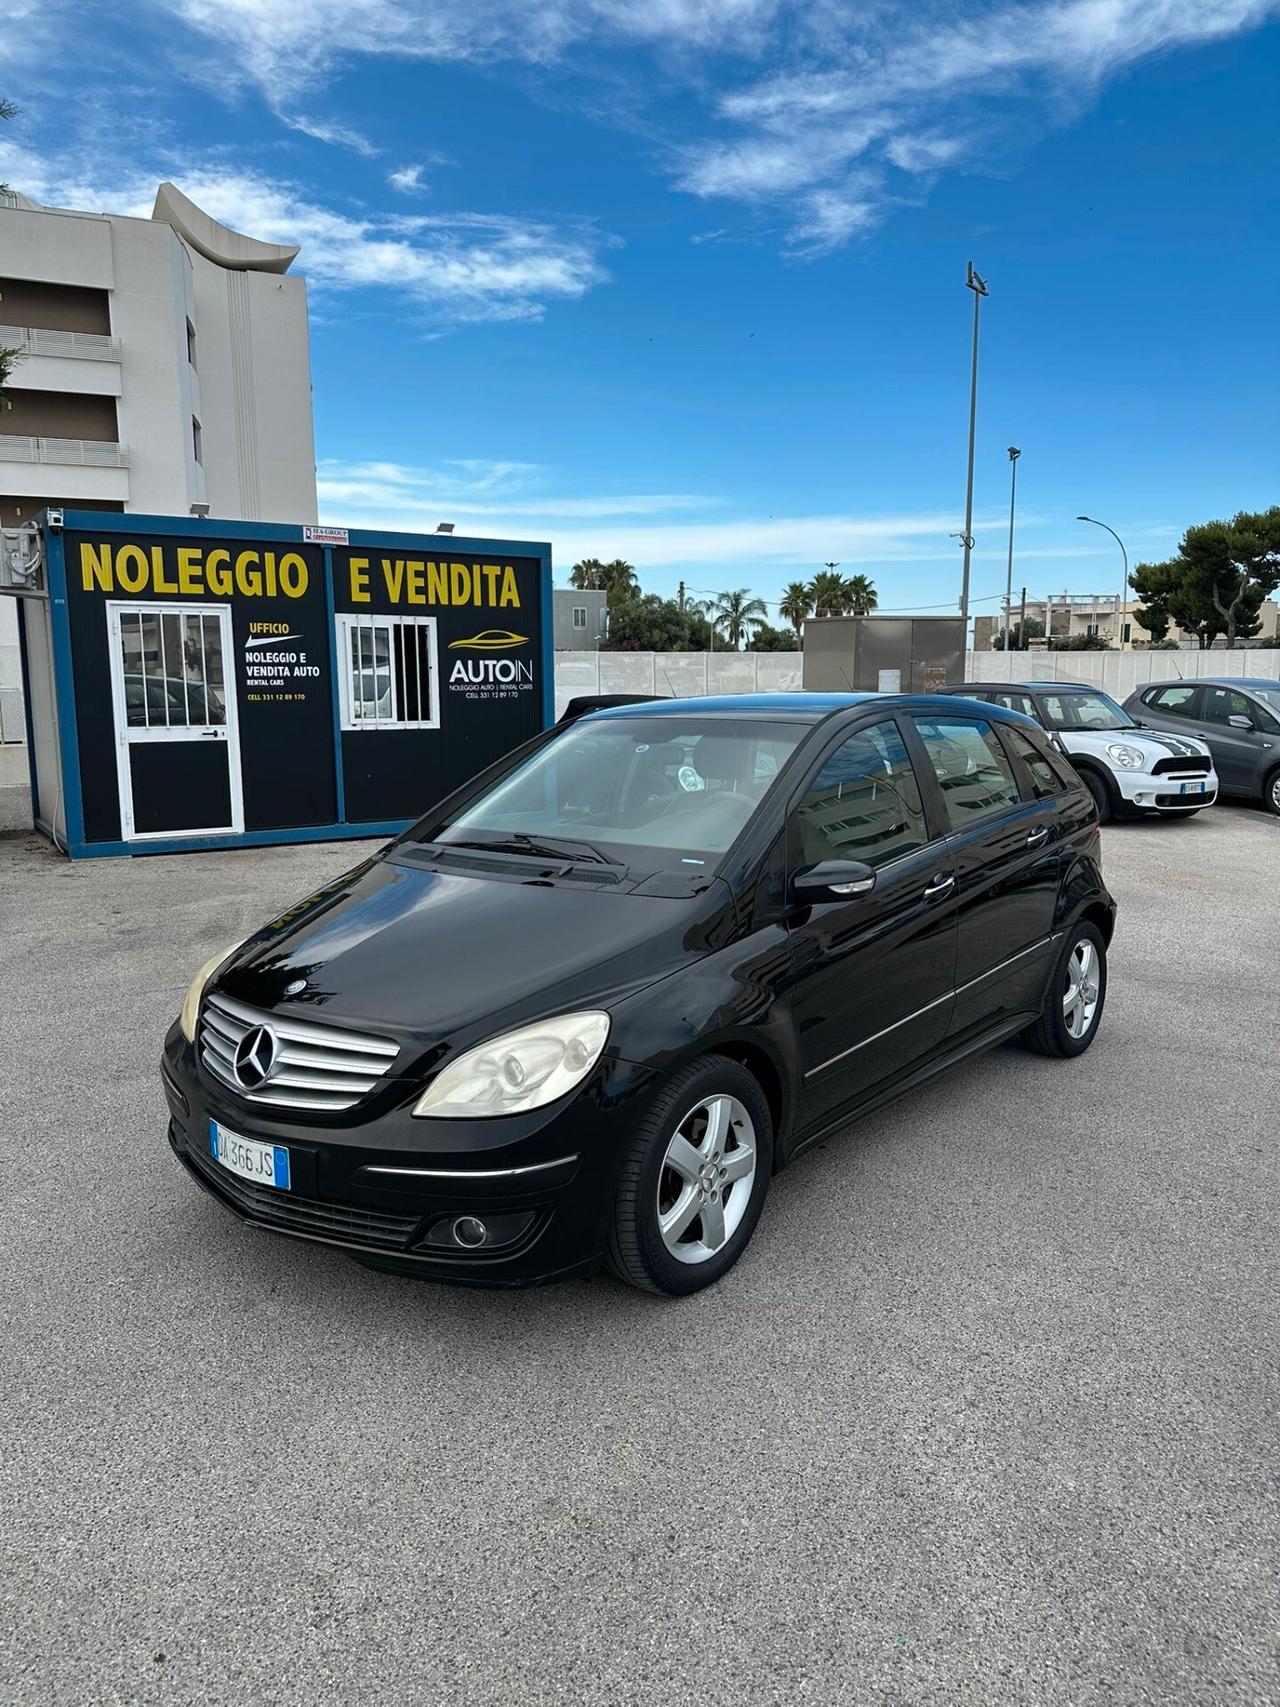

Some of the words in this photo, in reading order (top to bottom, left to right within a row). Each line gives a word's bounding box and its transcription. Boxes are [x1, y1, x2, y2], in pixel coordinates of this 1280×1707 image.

[80, 543, 308, 598] NOLEGGIO
[350, 558, 370, 602] E
[382, 559, 520, 607] VENDITA
[250, 623, 289, 633] UFFICIO
[245, 652, 296, 663] NOLEGGIO
[300, 653, 306, 663] E
[246, 666, 290, 676] VENDITA
[294, 667, 319, 676] AUTO
[499, 683, 518, 691] RENTAL
[491, 691, 499, 699] 12
